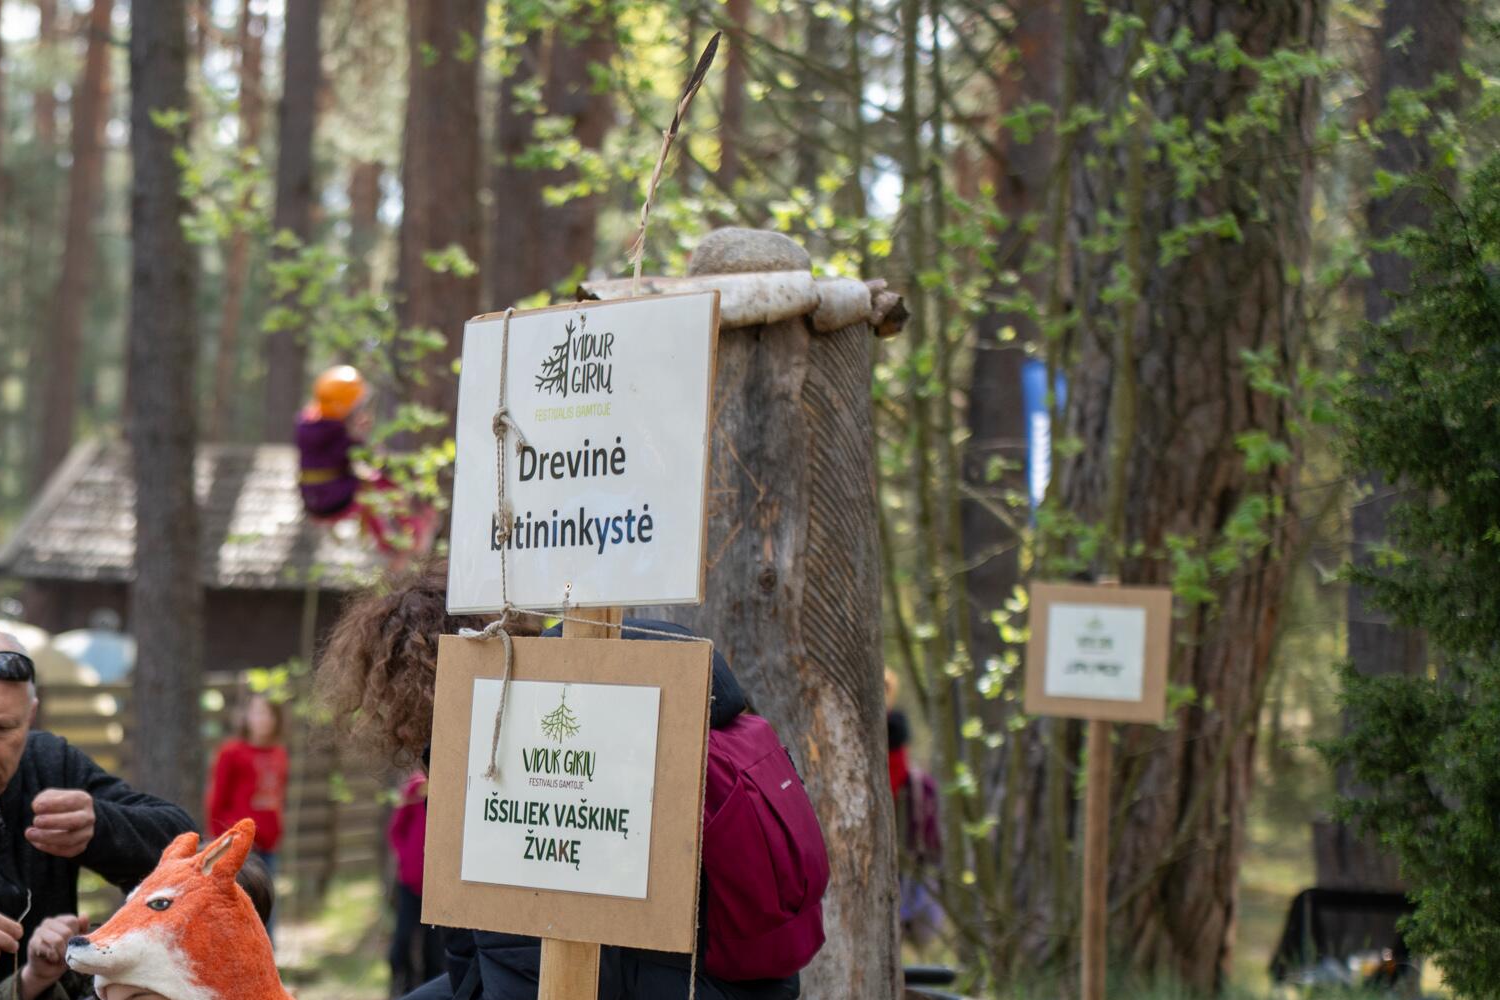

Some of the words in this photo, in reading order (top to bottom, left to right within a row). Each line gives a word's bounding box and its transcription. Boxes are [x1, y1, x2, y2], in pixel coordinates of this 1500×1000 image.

[573, 332, 615, 361] VIDUR
[571, 362, 613, 394] GIRIŲ
[534, 406, 574, 421] FESTIVALIS
[575, 401, 612, 418] GAMTOJE
[519, 436, 626, 482] Drevinė
[522, 747, 562, 774] VIDUR
[564, 749, 596, 782] GIRIŲ
[528, 777, 559, 788] FESTIVALIS
[559, 780, 585, 790] GAMTOJE
[484, 792, 550, 826] IŠSILIEK
[554, 798, 630, 840] VAŠKINĘ
[523, 829, 581, 871] ŽVAKĘ
